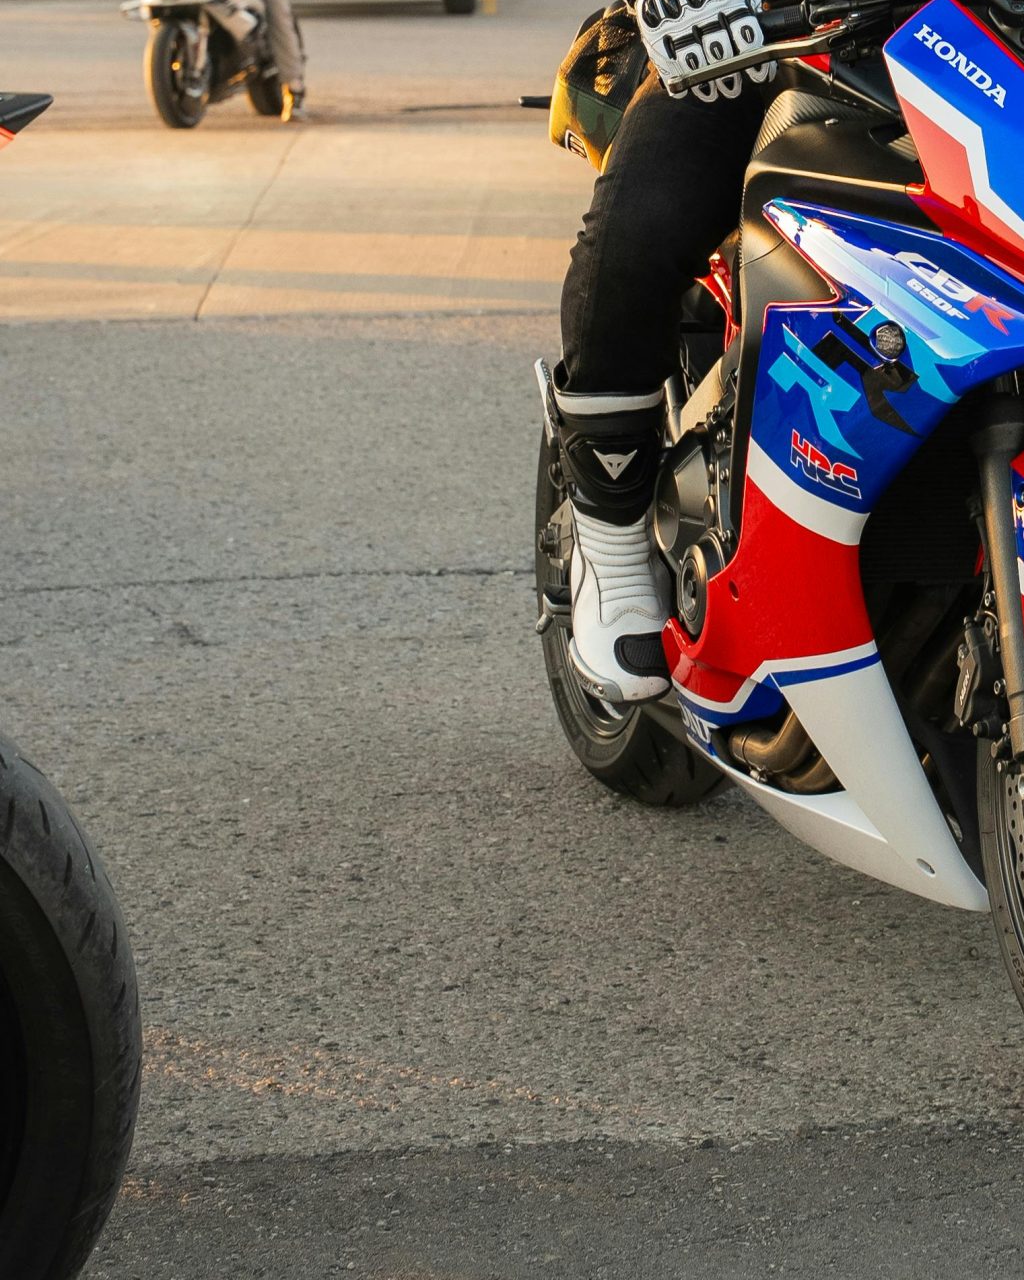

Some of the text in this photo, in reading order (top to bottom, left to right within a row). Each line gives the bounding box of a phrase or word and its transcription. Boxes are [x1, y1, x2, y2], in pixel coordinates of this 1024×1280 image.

[913, 23, 1007, 109] HONDA
[894, 251, 1016, 337] CBR
[906, 278, 970, 321] 650F
[790, 428, 863, 500] HRC
